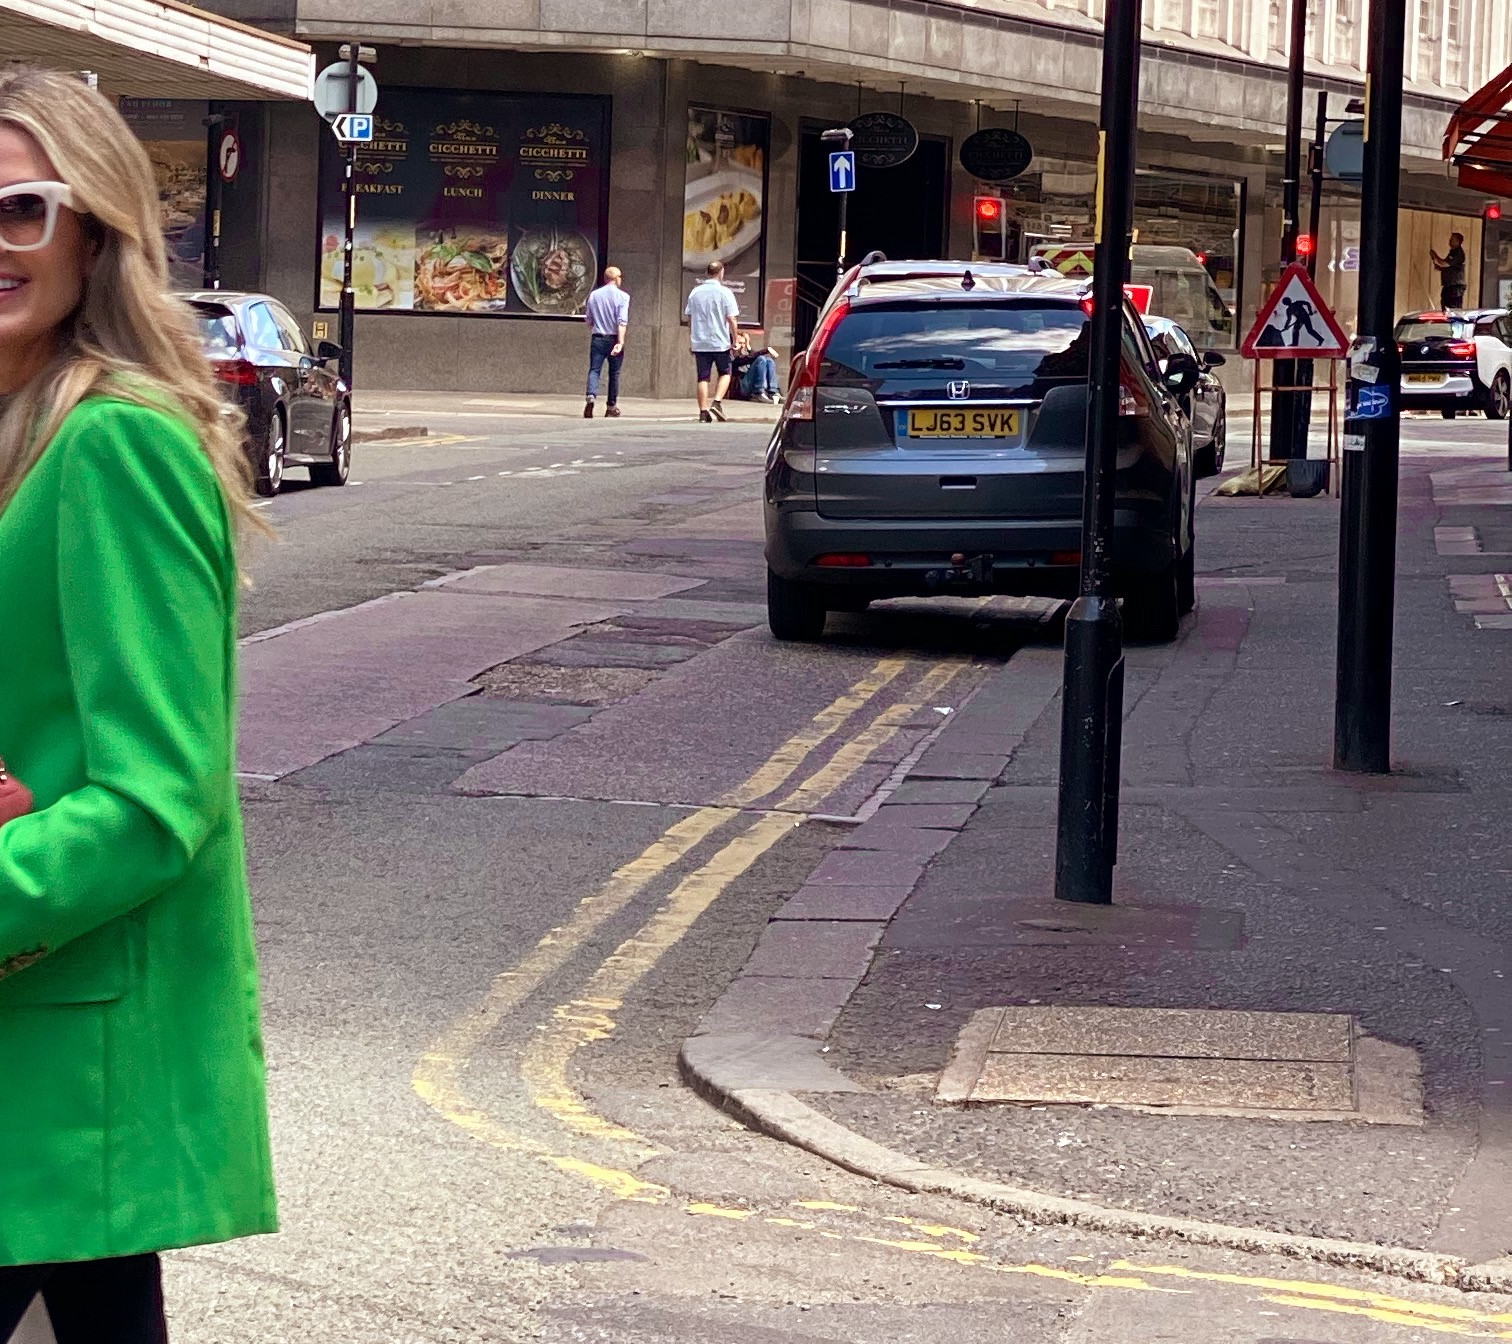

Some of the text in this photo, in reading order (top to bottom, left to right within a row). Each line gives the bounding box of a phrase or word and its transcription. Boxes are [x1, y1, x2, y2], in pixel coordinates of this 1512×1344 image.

[354, 119, 368, 137] P
[429, 143, 497, 155] CICCHETTI
[519, 147, 587, 159] CICCHETTI
[443, 187, 483, 198] LUNCH
[532, 190, 575, 201] DINNER
[911, 413, 1013, 432] LJ63 SVK
